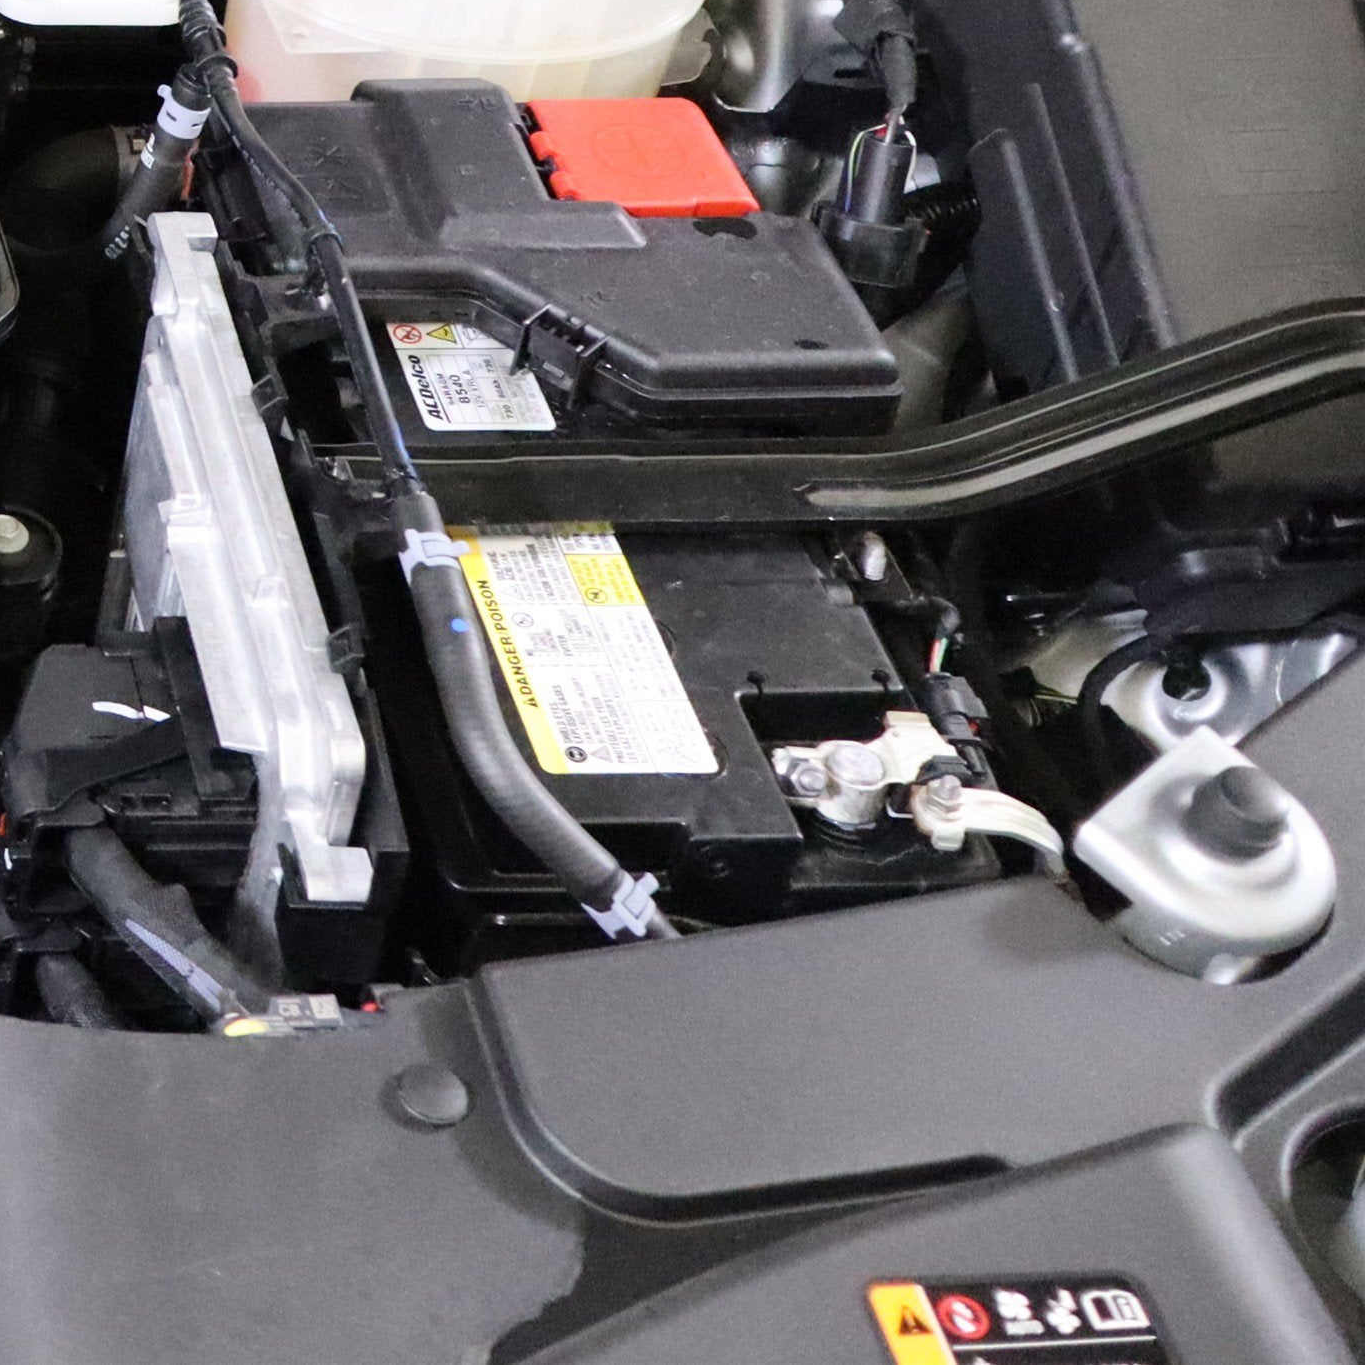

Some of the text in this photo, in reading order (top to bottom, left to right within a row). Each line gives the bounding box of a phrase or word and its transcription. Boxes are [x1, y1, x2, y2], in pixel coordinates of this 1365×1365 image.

[409, 354, 442, 420] ACDelco
[450, 374, 470, 403] 8540
[562, 708, 583, 743] EXPLOSIVE
